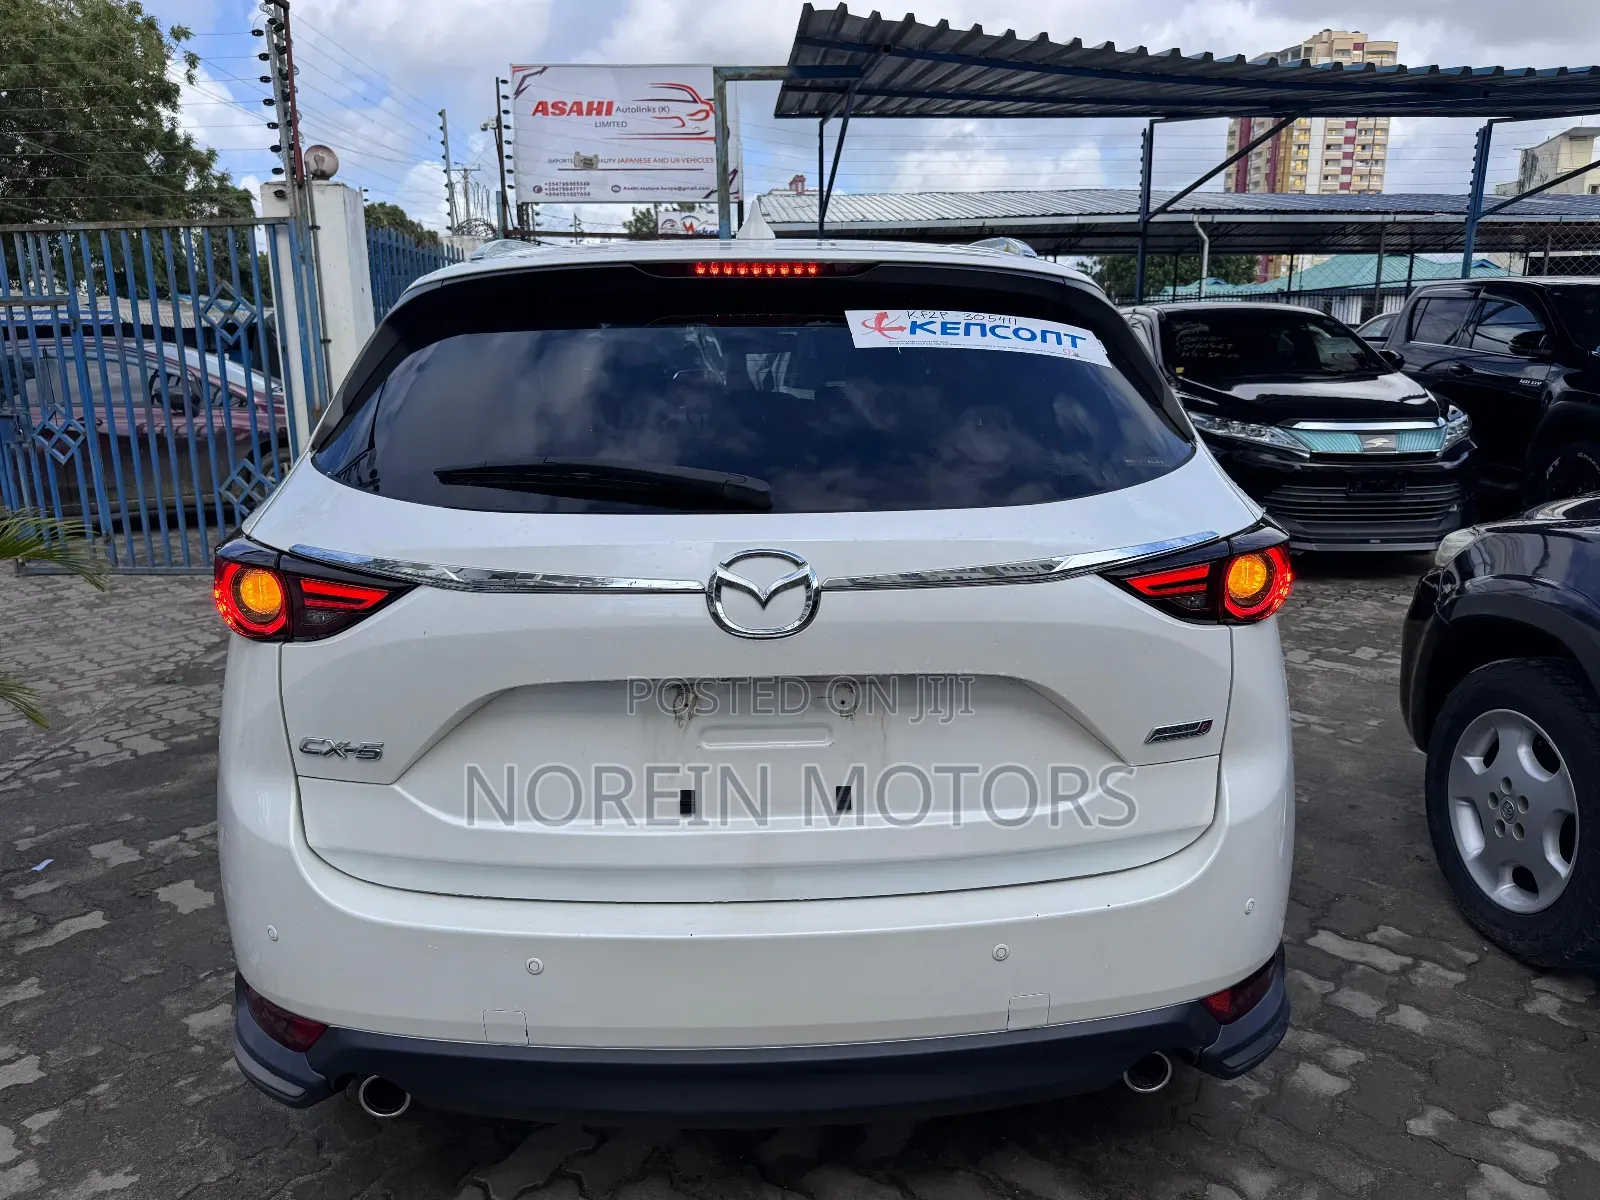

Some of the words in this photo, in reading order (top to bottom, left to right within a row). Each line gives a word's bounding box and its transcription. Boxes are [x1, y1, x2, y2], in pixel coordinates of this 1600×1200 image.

[532, 101, 614, 117] ASAHI
[616, 105, 656, 114] Autolinks
[658, 105, 671, 115] (K)
[594, 121, 628, 129] LIMITED
[299, 736, 385, 761] CX-5
